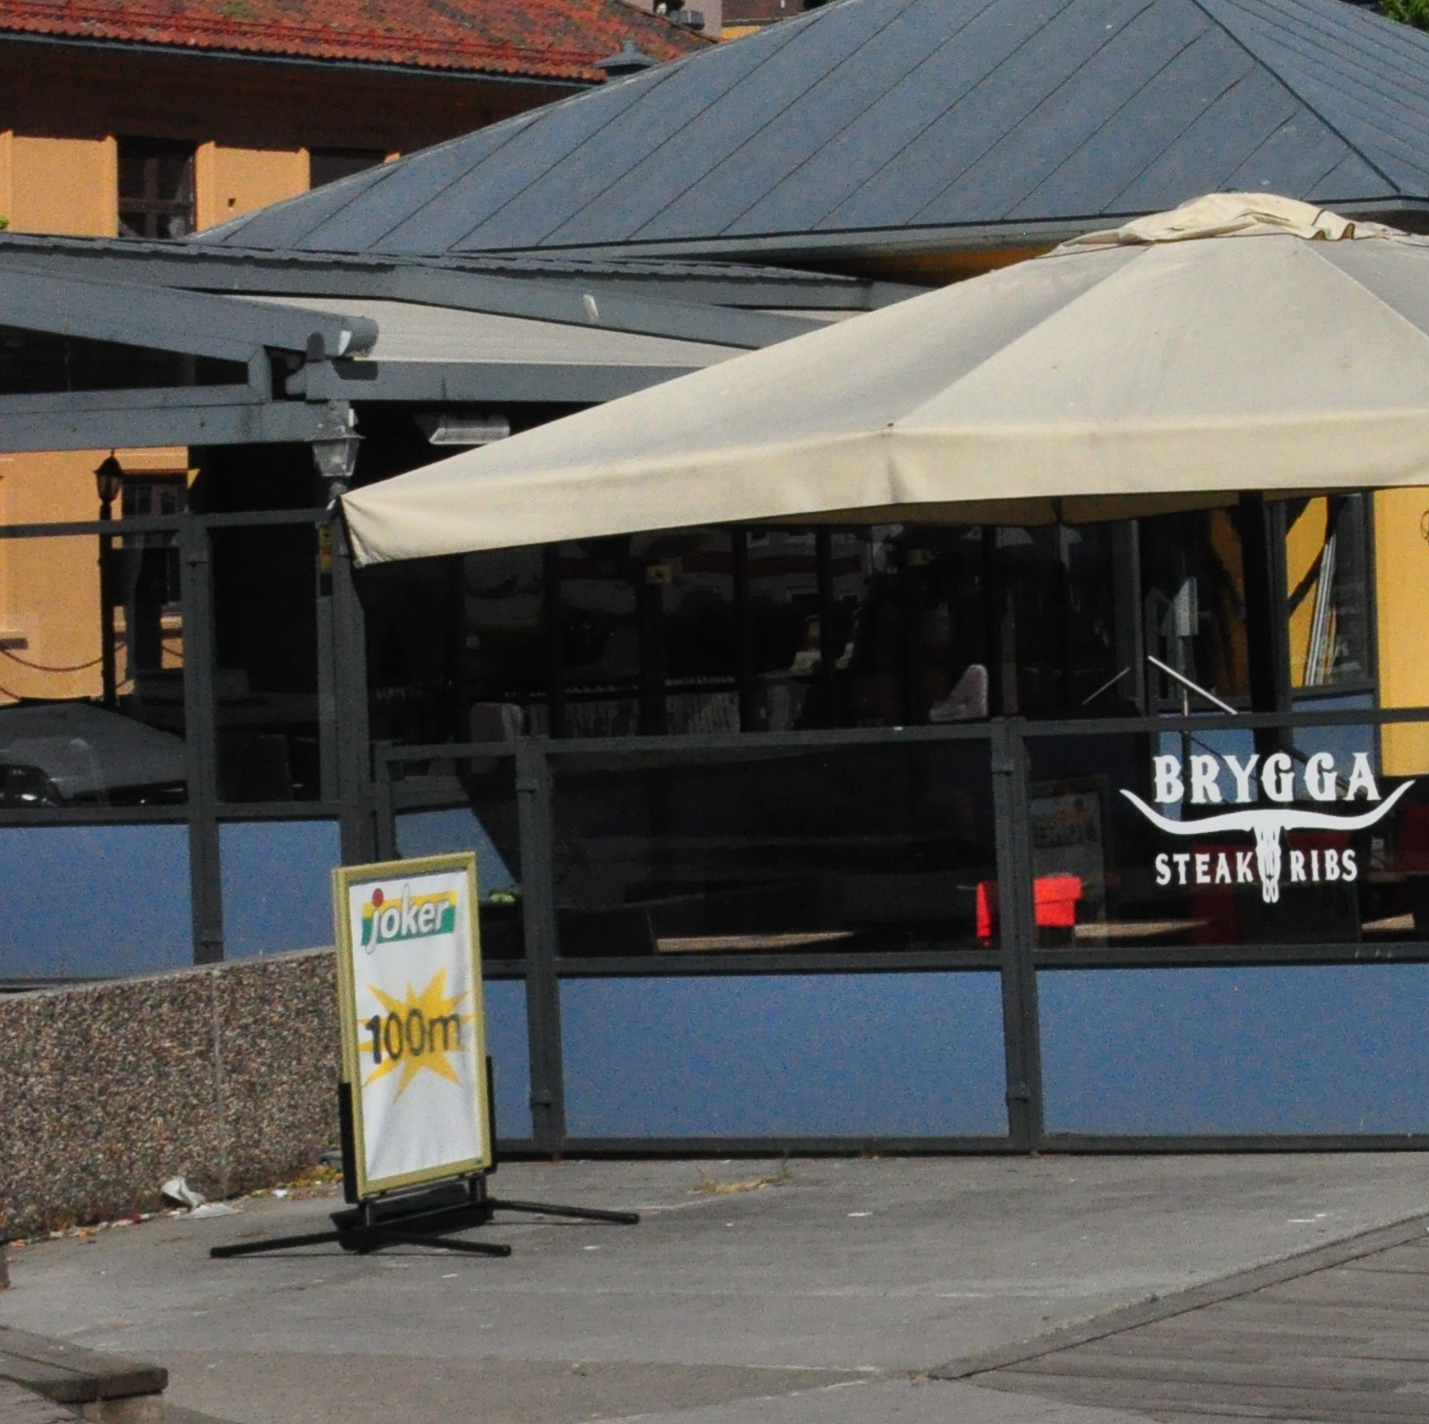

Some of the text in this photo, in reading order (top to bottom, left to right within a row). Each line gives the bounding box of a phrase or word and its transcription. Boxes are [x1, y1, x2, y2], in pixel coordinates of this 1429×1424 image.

[1153, 752, 1382, 804] BRYGGA
[1155, 849, 1359, 886] STEAK RIBS
[365, 883, 450, 955] joker
[364, 1008, 460, 1064] 100m
